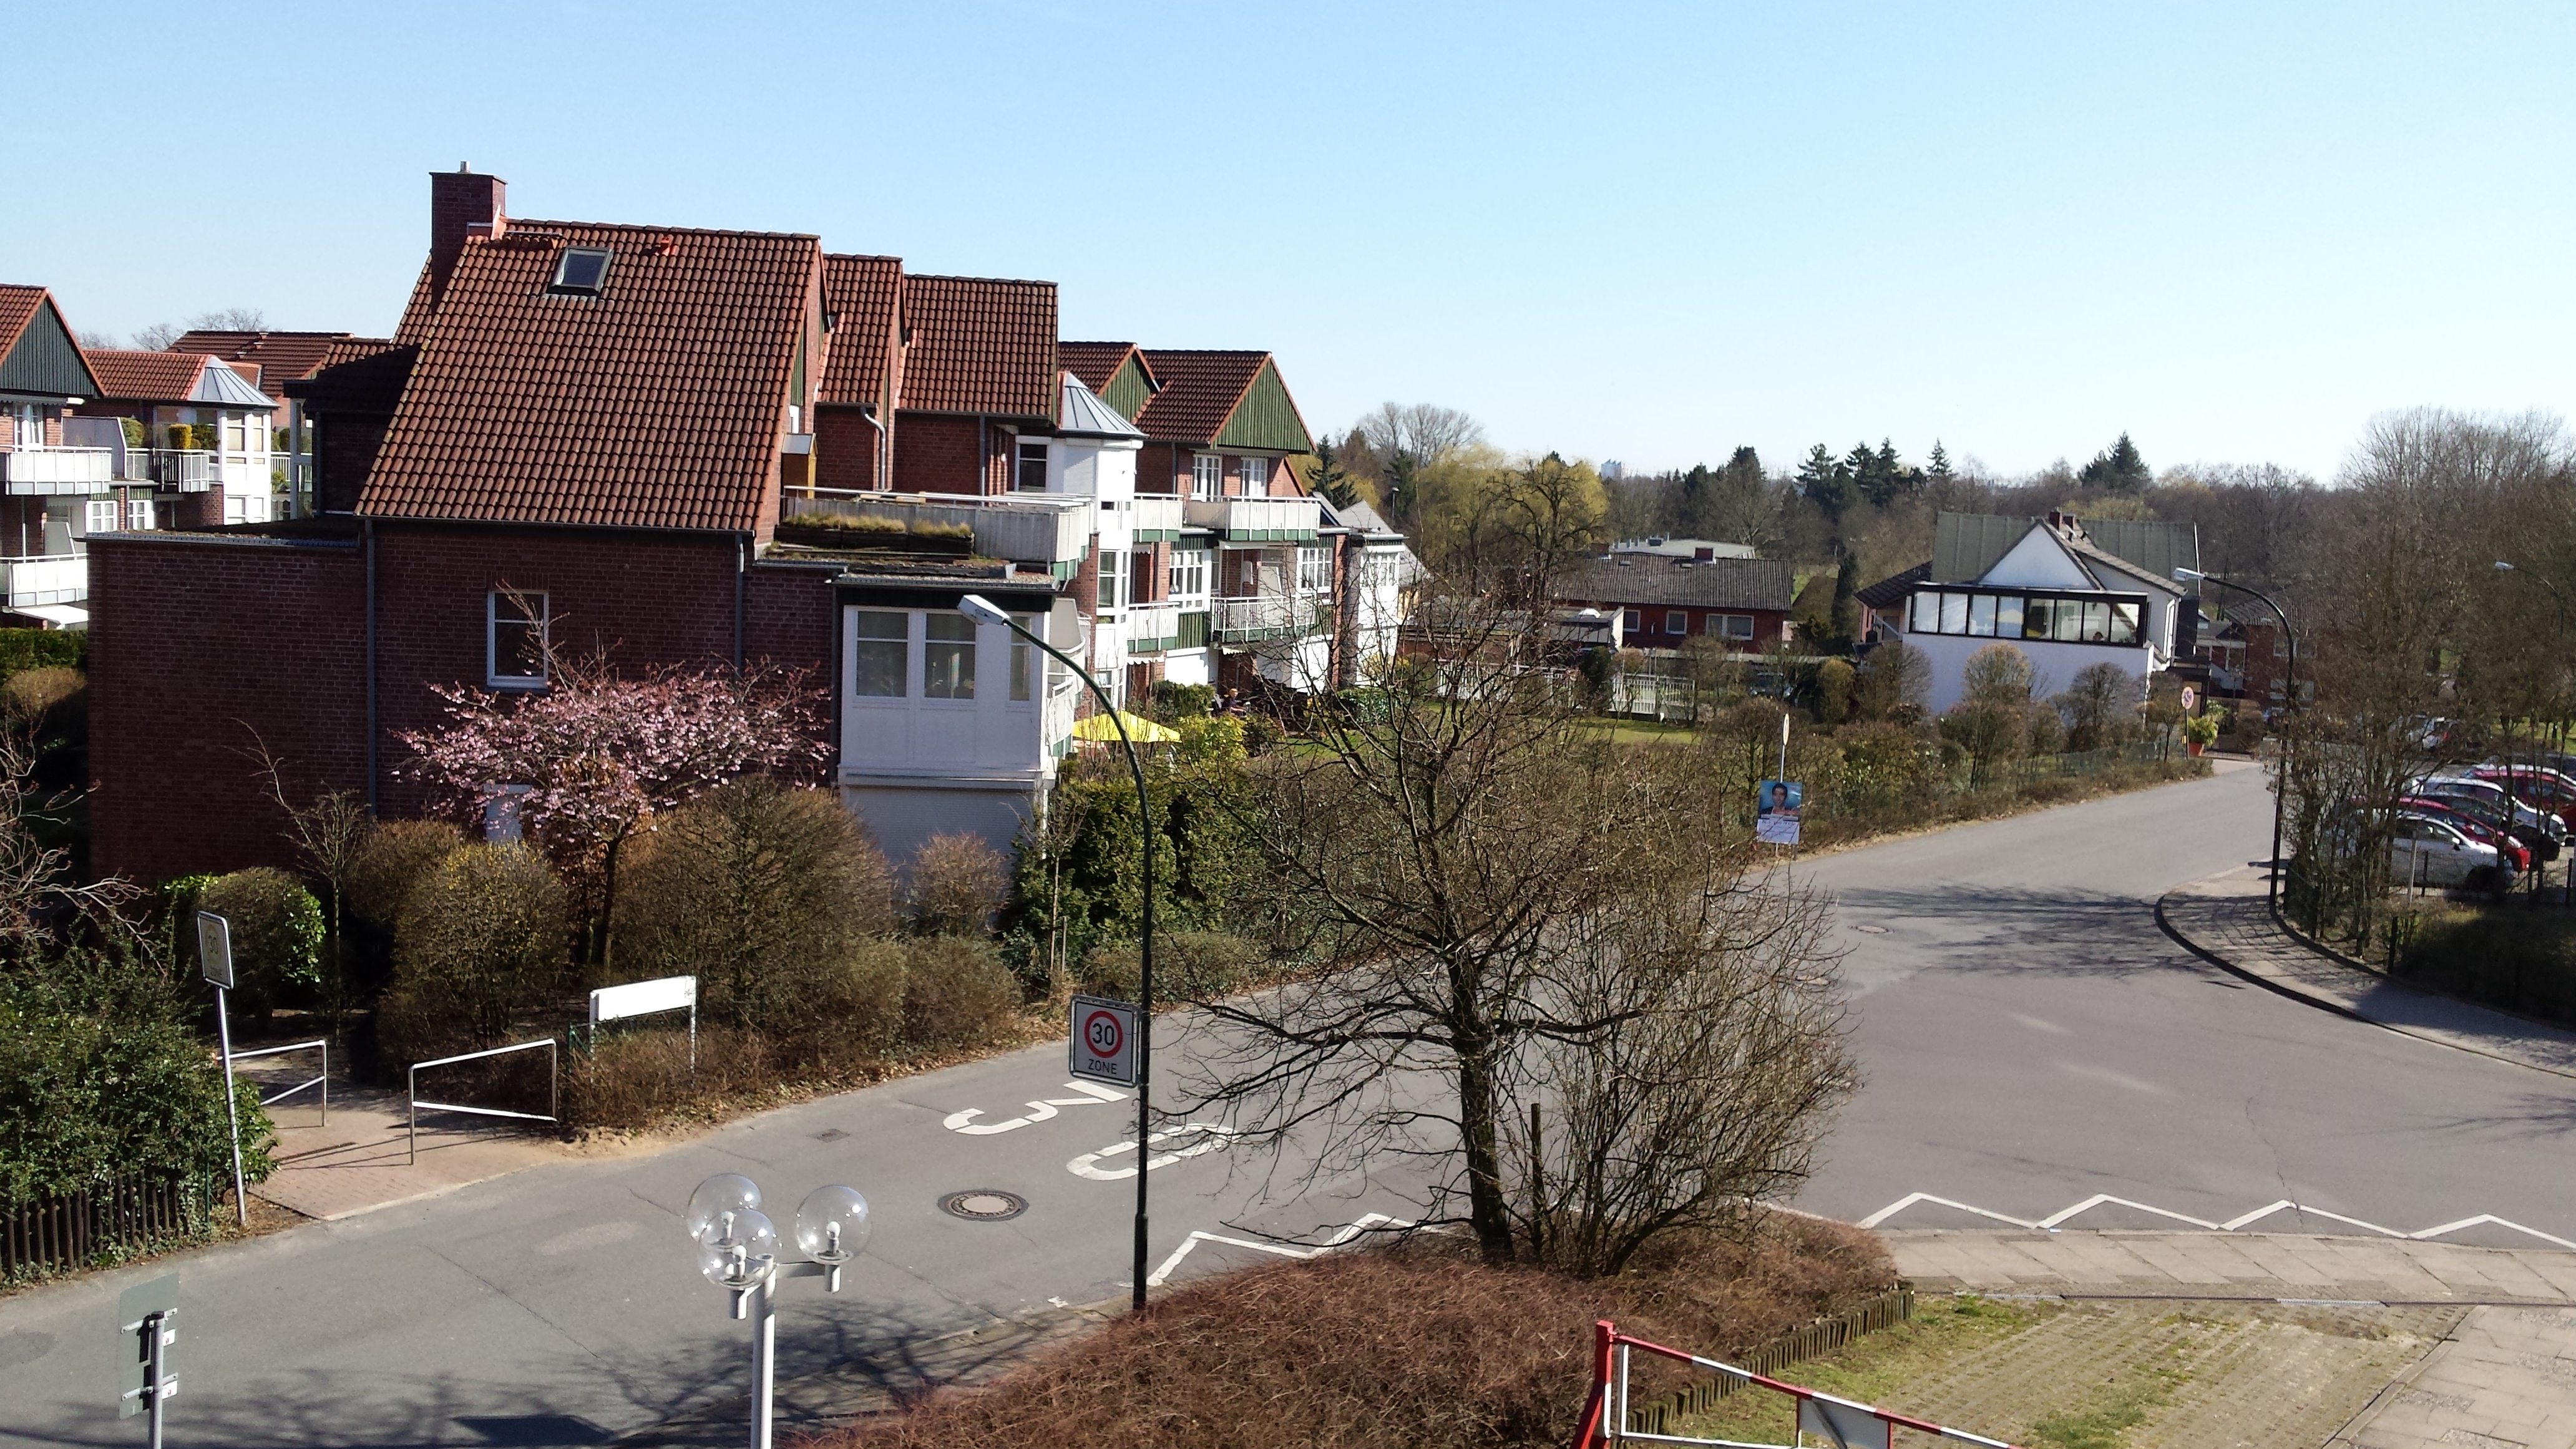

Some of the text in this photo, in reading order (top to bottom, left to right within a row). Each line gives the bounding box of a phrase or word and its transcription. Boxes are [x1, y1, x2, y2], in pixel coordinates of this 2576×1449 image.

[208, 934, 218, 955] 30
[1092, 1023, 1115, 1046] 30
[1088, 1058, 1117, 1075] ZONE
[944, 1081, 1244, 1181] 30
